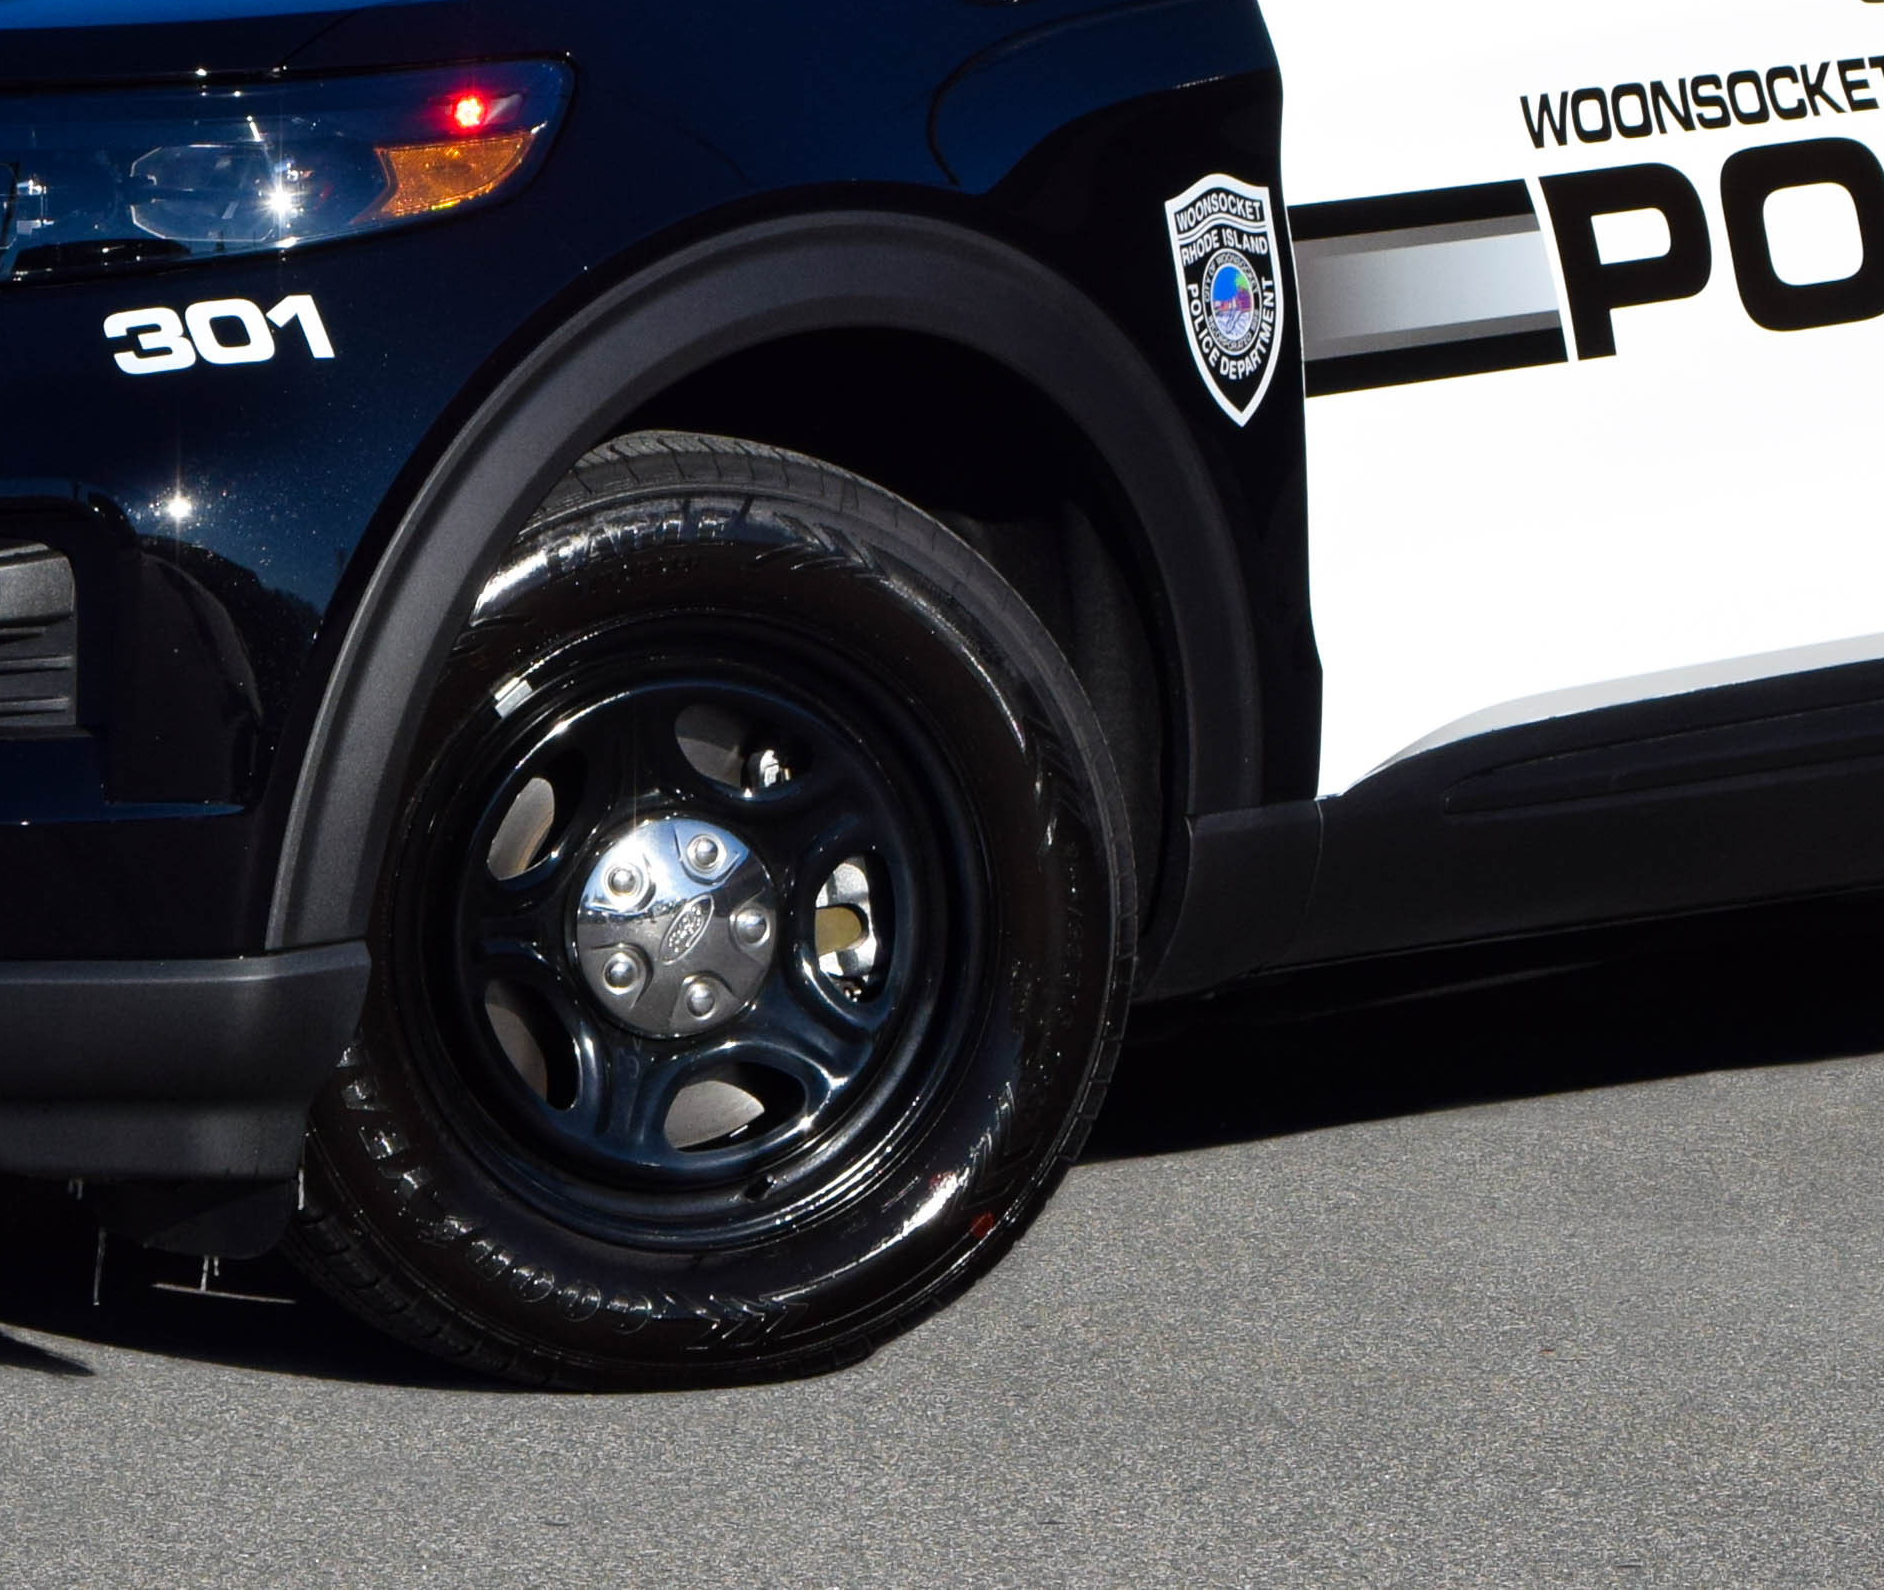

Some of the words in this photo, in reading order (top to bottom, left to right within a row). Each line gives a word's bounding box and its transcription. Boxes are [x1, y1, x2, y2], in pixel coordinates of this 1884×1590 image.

[1177, 192, 1261, 232] WOONSOCKET
[1181, 229, 1220, 267] RHODE
[1222, 228, 1269, 256] ISLAND
[103, 294, 335, 375] 301
[1188, 283, 1220, 368] POLICE
[1219, 276, 1275, 380] DEPARTMENT
